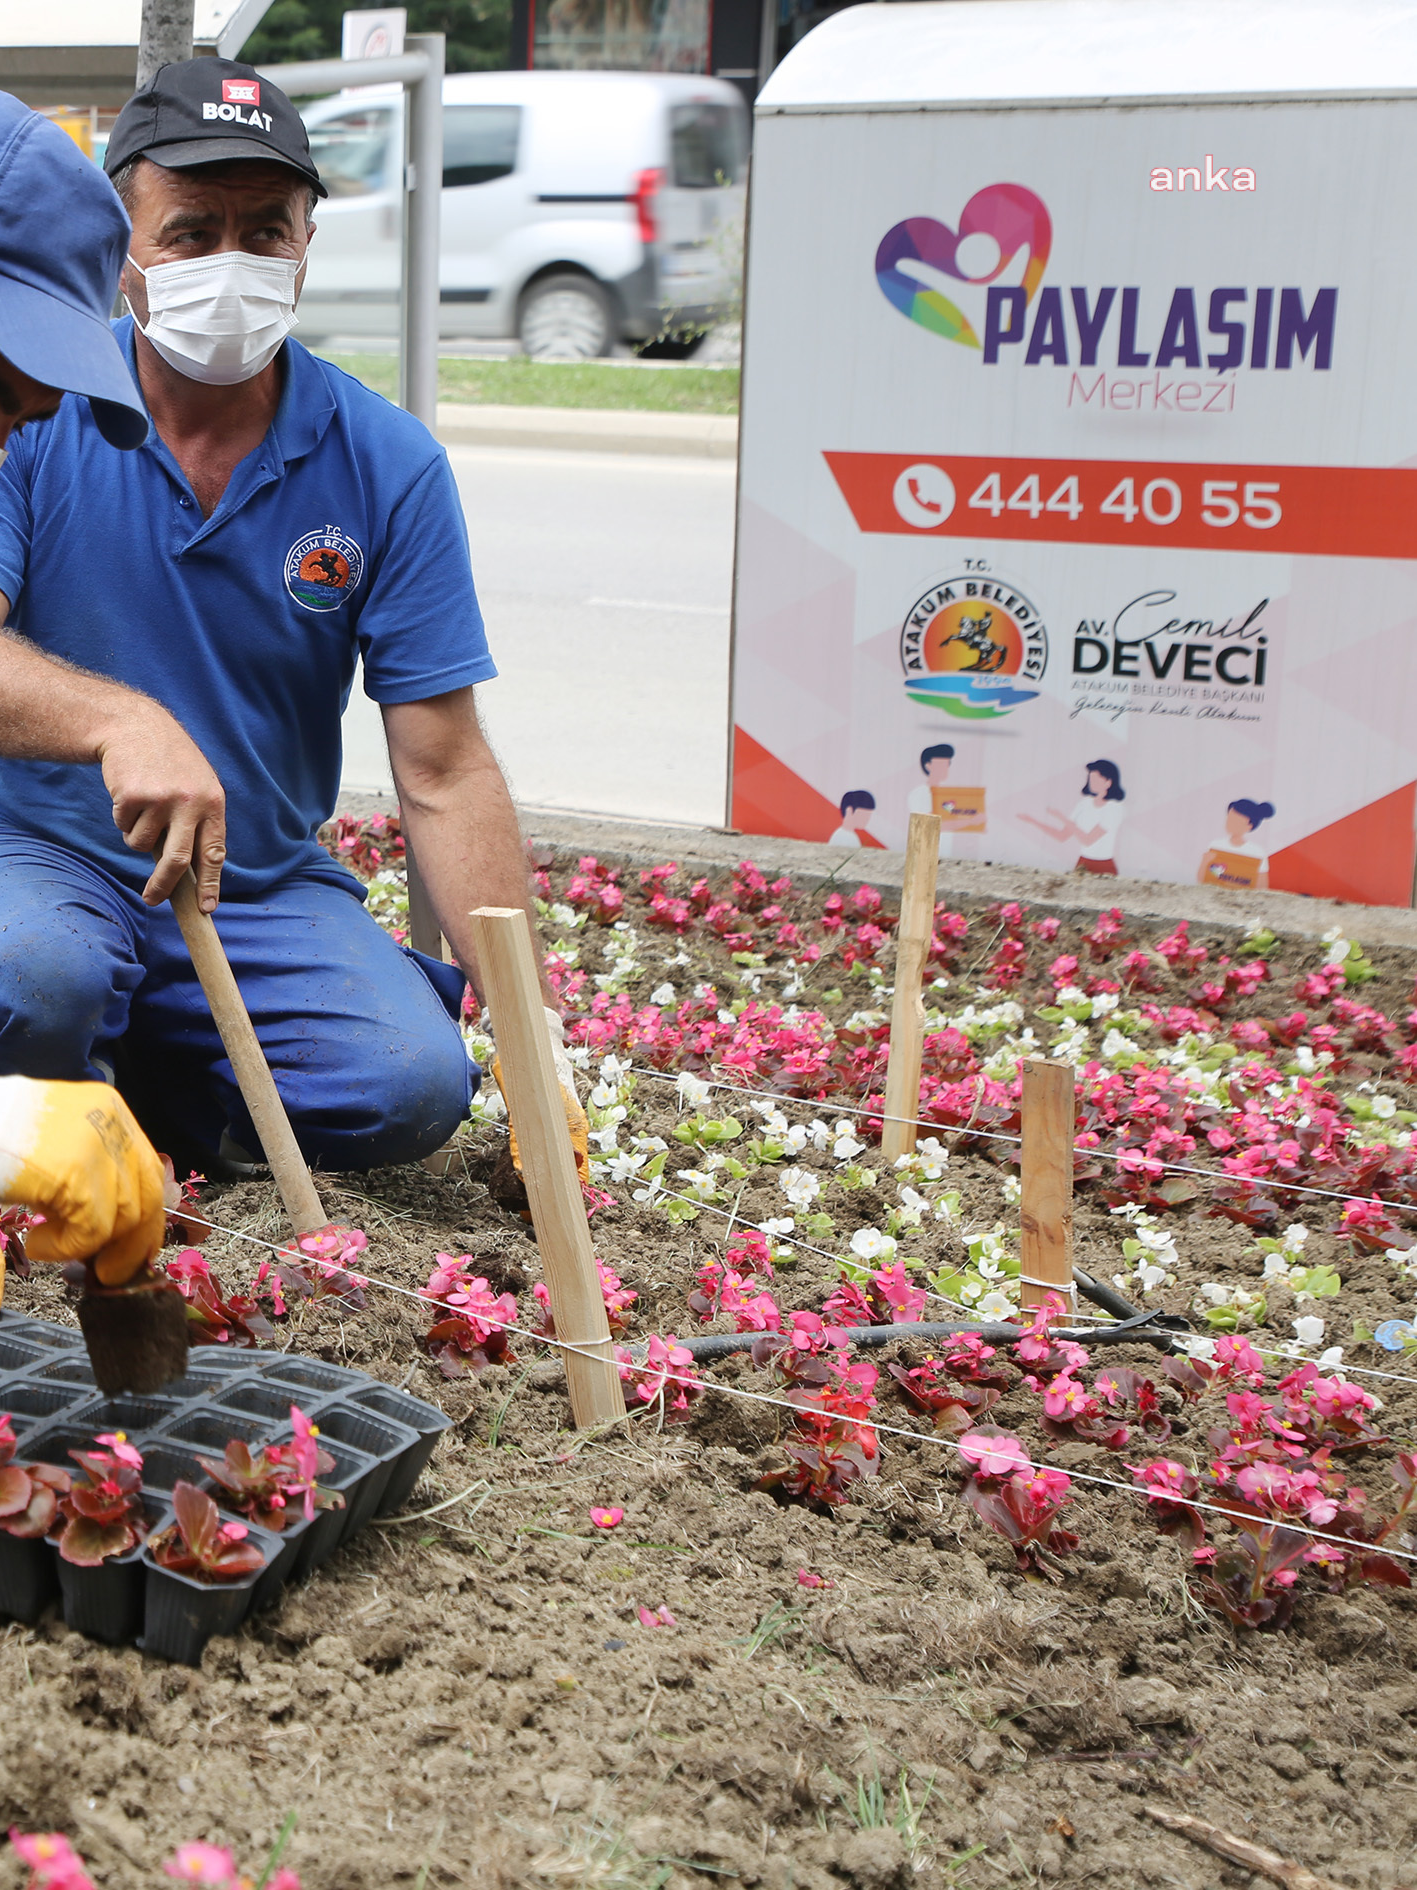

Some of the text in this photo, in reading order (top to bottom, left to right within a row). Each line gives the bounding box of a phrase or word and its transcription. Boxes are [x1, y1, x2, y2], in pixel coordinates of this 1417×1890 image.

[202, 102, 273, 133] BOLAT
[983, 286, 1339, 376] PAYLAŞIM
[1068, 371, 1237, 413] Merkezi
[968, 471, 1283, 530] 444 40 55
[290, 539, 320, 578] ATAKUM
[964, 558, 992, 572] T.C.
[905, 587, 956, 671] ATAKUM
[1075, 589, 1270, 644] AV. Cemil
[1072, 635, 1269, 686] DEVECİ
